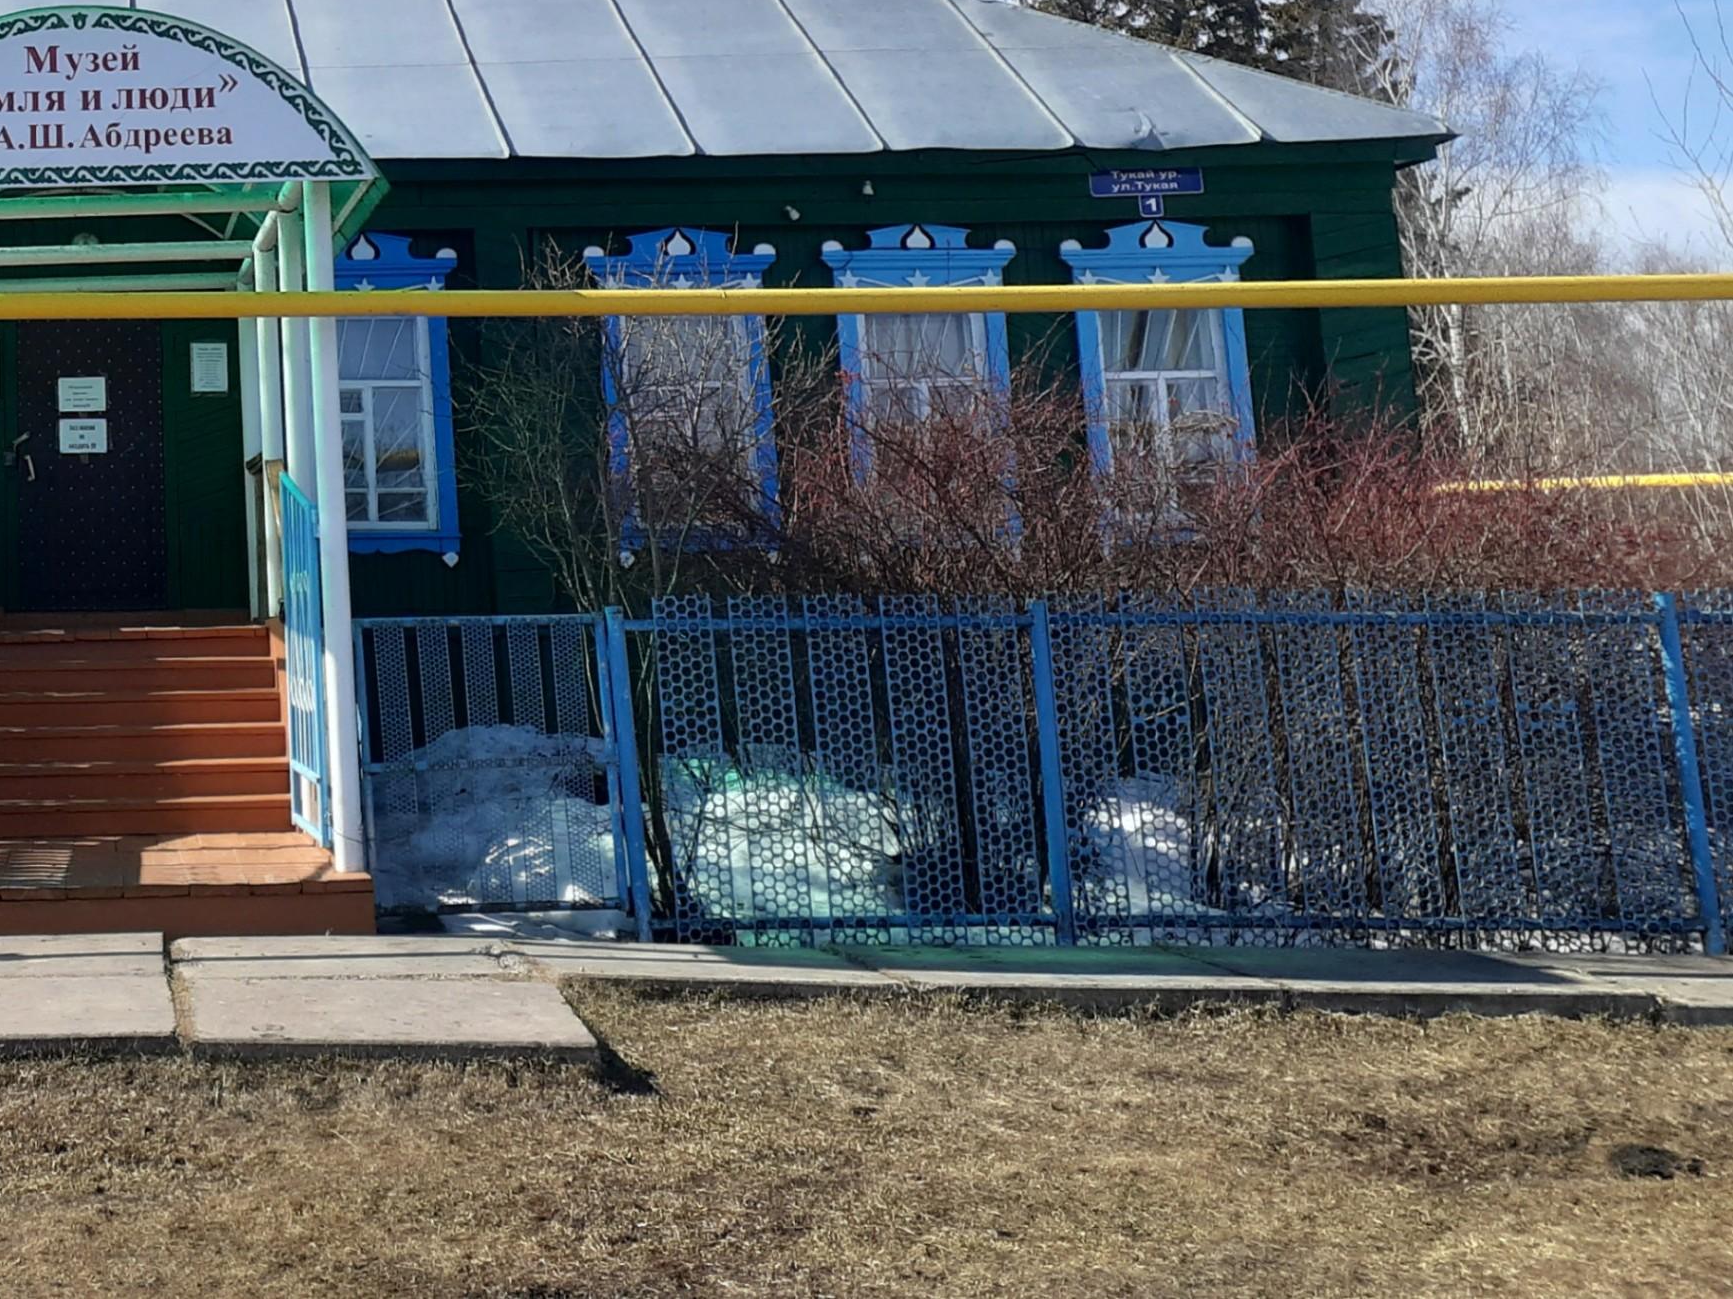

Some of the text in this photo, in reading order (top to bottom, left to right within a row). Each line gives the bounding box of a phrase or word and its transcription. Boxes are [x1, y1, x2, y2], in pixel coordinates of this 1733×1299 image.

[22, 43, 141, 82] Музей
[79, 89, 103, 112] и
[111, 73, 239, 114] люди»
[1145, 197, 1157, 212] 1
